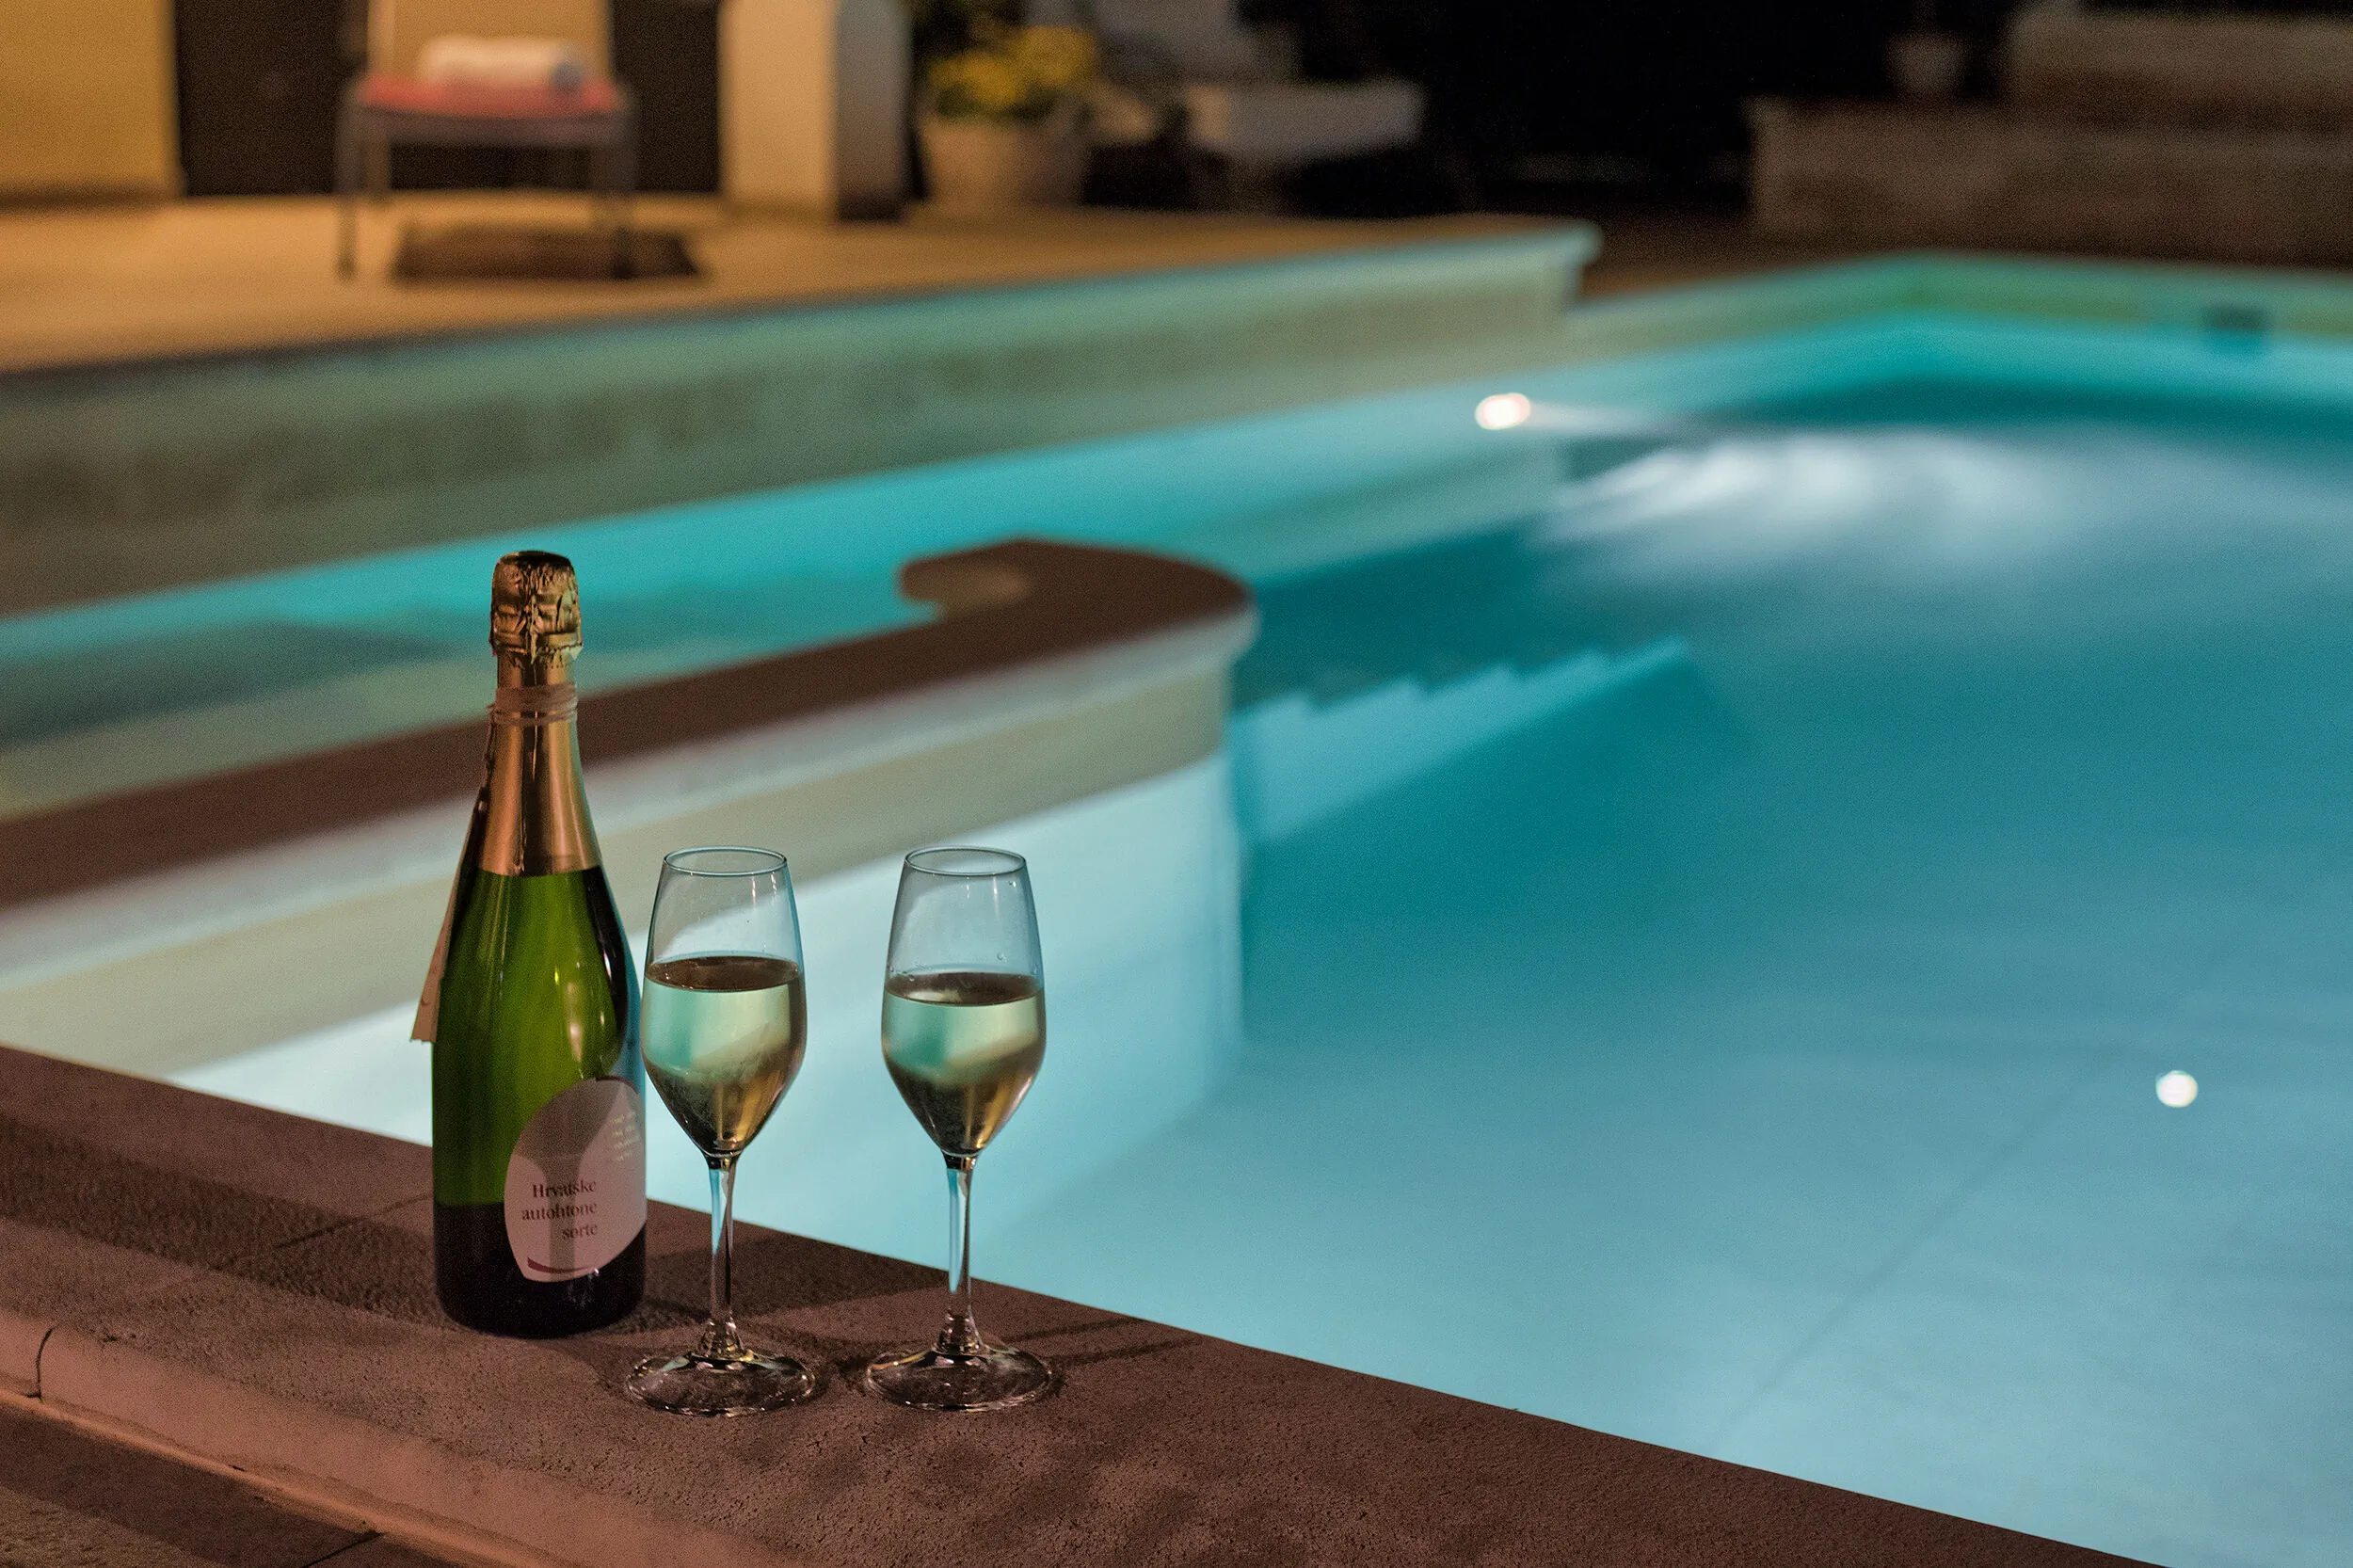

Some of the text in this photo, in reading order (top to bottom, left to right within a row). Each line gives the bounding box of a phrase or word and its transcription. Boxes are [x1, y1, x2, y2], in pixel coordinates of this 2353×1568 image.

[532, 1180, 596, 1198] Hrvatske
[521, 1204, 597, 1221] autohtone
[562, 1224, 598, 1240] sorte
